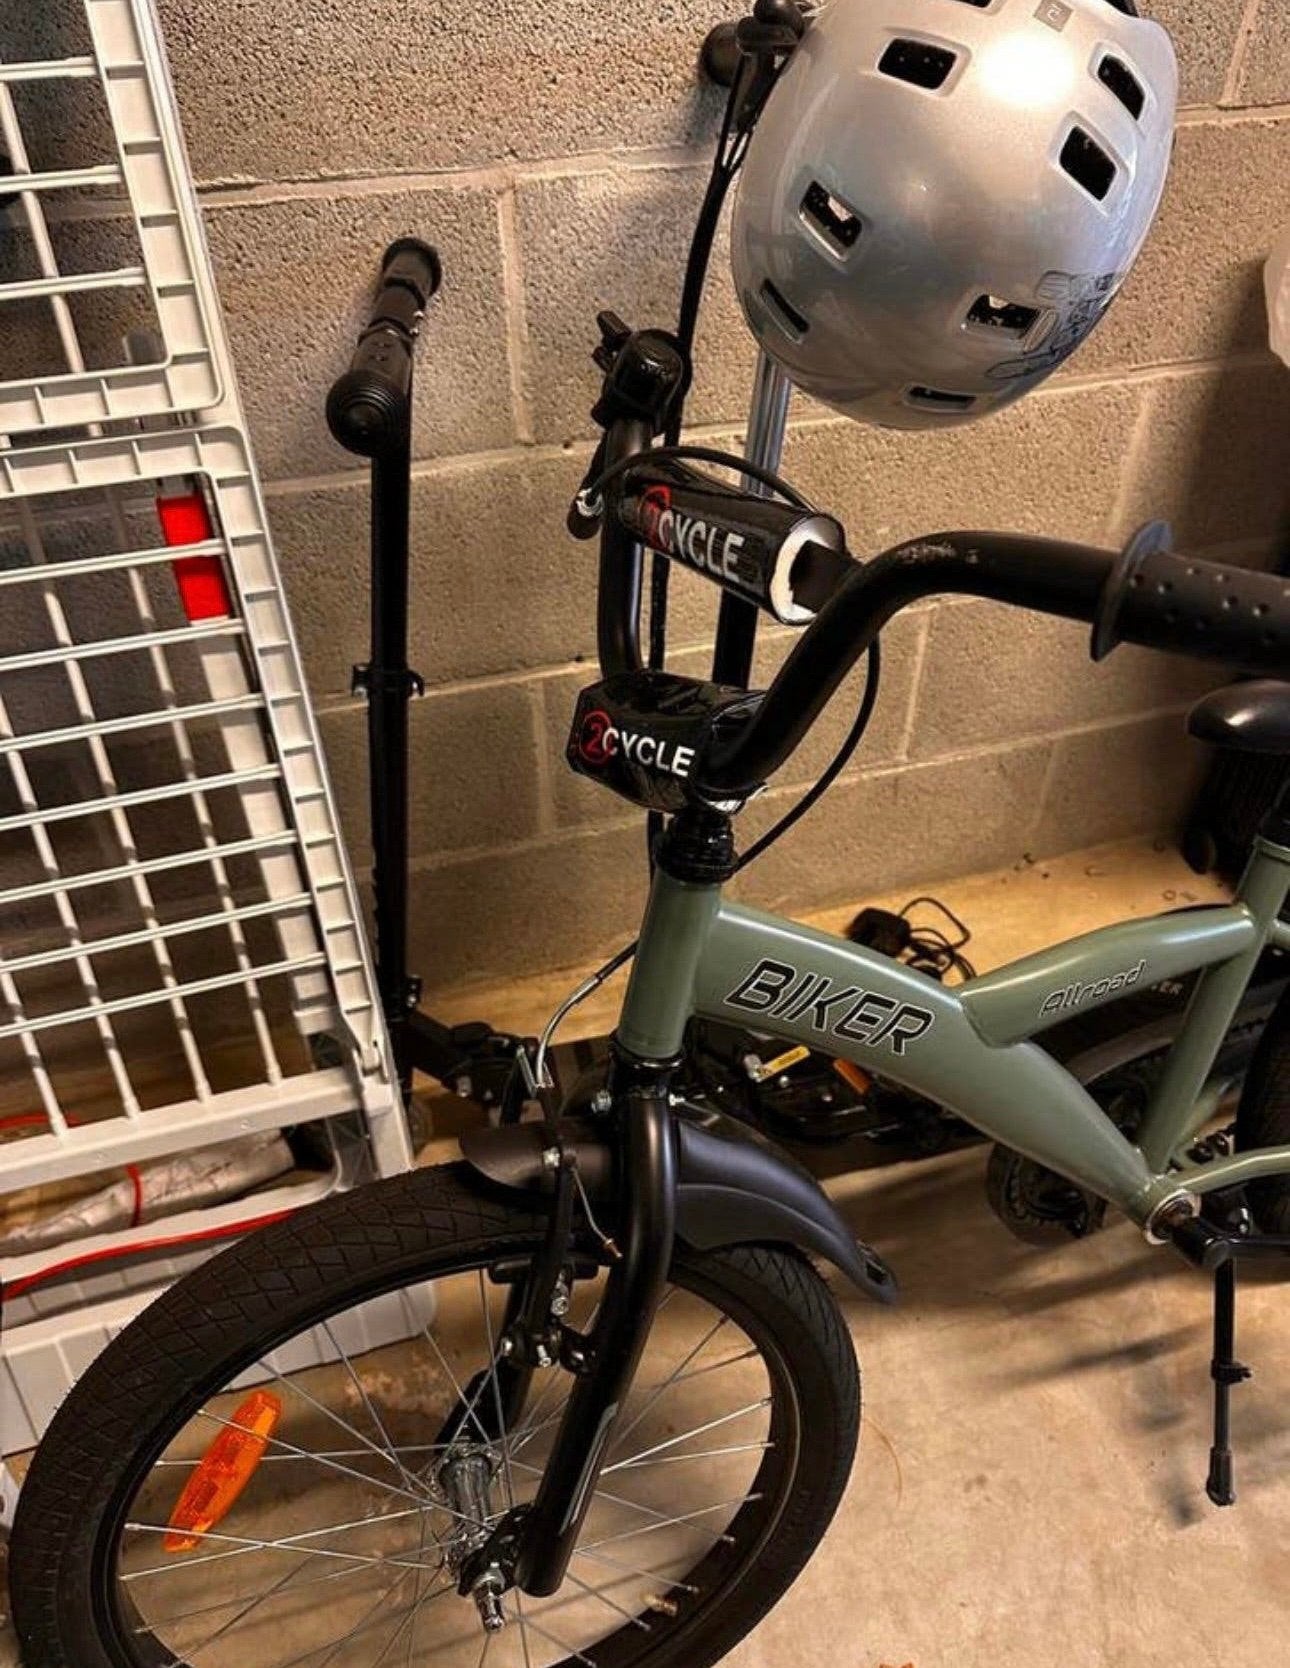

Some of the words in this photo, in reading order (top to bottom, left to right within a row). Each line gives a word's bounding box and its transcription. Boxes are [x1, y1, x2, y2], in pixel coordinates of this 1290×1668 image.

[580, 710, 695, 777] 2CYCLE
[724, 958, 935, 1055] BIKER
[1039, 959, 1147, 1018] Allroad
